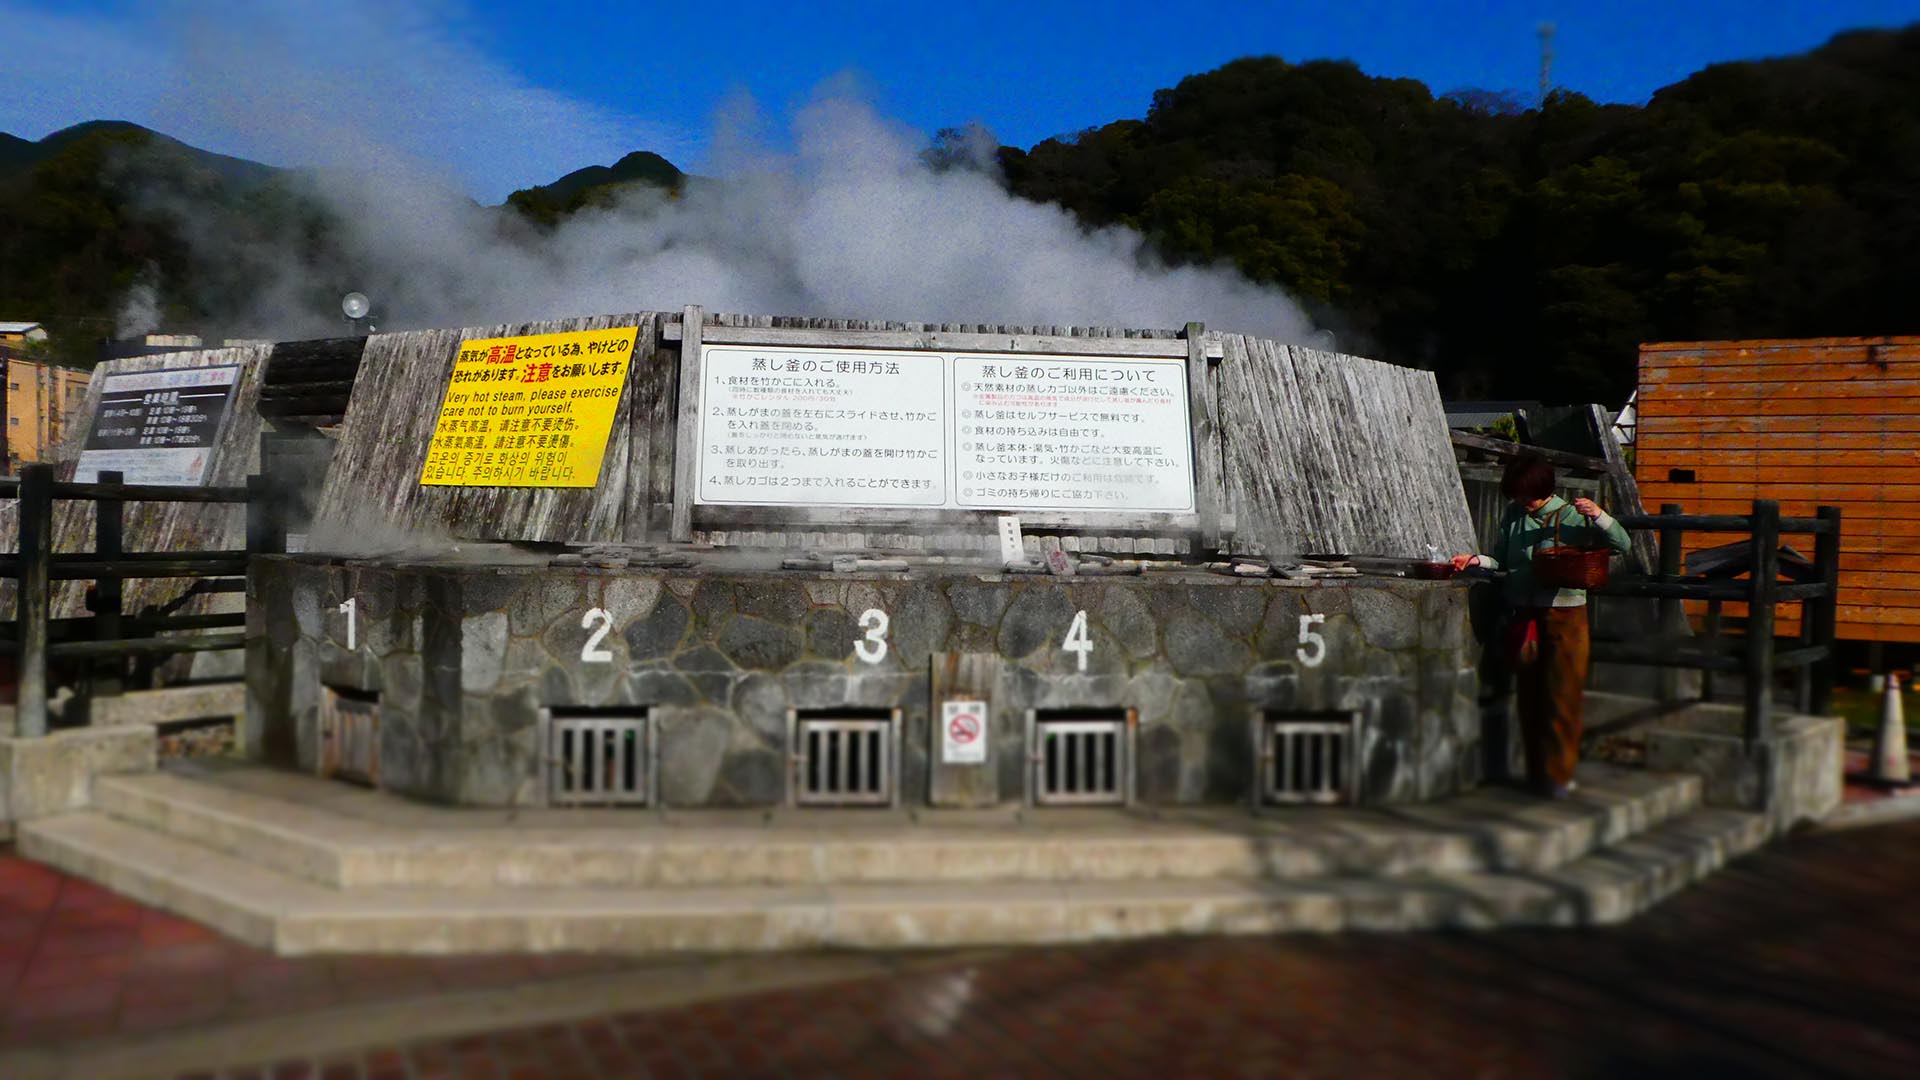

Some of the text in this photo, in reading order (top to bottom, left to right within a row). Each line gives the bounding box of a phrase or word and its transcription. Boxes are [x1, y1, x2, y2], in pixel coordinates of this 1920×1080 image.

[460, 338, 629, 364] 蒸気が高温となっている為、やけどの
[453, 362, 624, 384] 恐れがあります。注意をお願いします。
[752, 357, 900, 376] 蒸し釜のご使用方法
[982, 365, 1156, 382] 蒸し釜のご利用について
[448, 392, 468, 404] Very
[472, 391, 490, 402] hot
[530, 388, 566, 402] please
[571, 385, 618, 399] exercise
[443, 402, 572, 418] care not to burn yourself.
[975, 426, 1105, 438] 食材の持ち込みは自由です。
[429, 452, 568, 467] 고온의 증기로 화상의 위험이
[726, 458, 785, 468] を取り出す。
[472, 466, 524, 480] 주의하시기
[529, 466, 576, 481] 바랍니다.
[339, 598, 355, 650] 1
[581, 607, 614, 662] 2
[853, 608, 889, 665] 3
[1062, 610, 1094, 671] 4
[1297, 614, 1326, 668] 5
